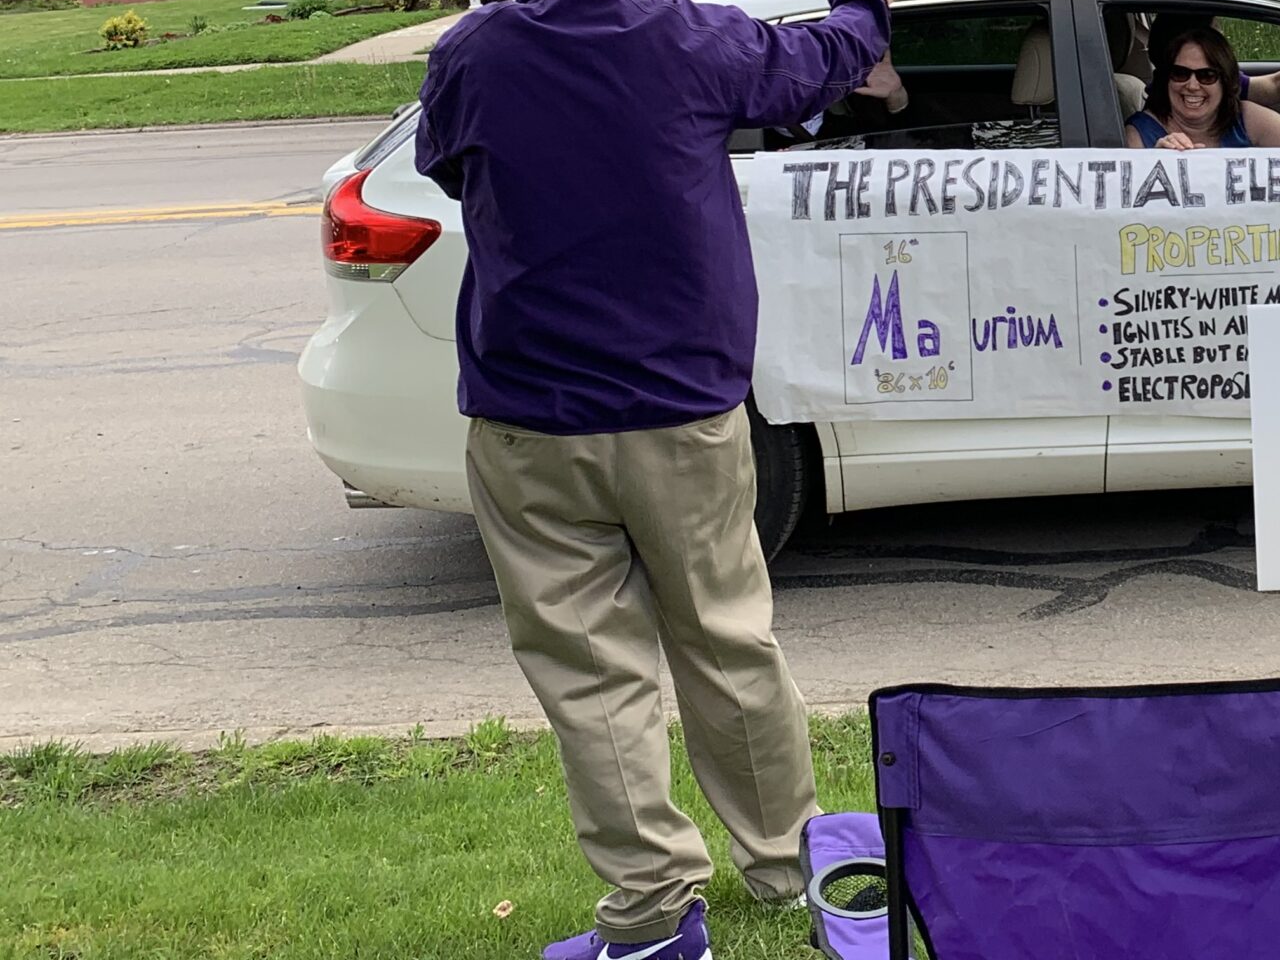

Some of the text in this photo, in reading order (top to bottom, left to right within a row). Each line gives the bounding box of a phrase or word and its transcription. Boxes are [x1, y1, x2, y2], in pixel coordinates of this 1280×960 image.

[782, 157, 875, 221] THE
[884, 156, 1206, 218] PRESIDENTIAL
[1113, 284, 1259, 316] SILVERY-WHITE
[851, 270, 941, 366] Ma
[1112, 314, 1249, 345] IGNITES IN AI
[1110, 346, 1187, 370] STABLE
[1193, 344, 1232, 364] BUT
